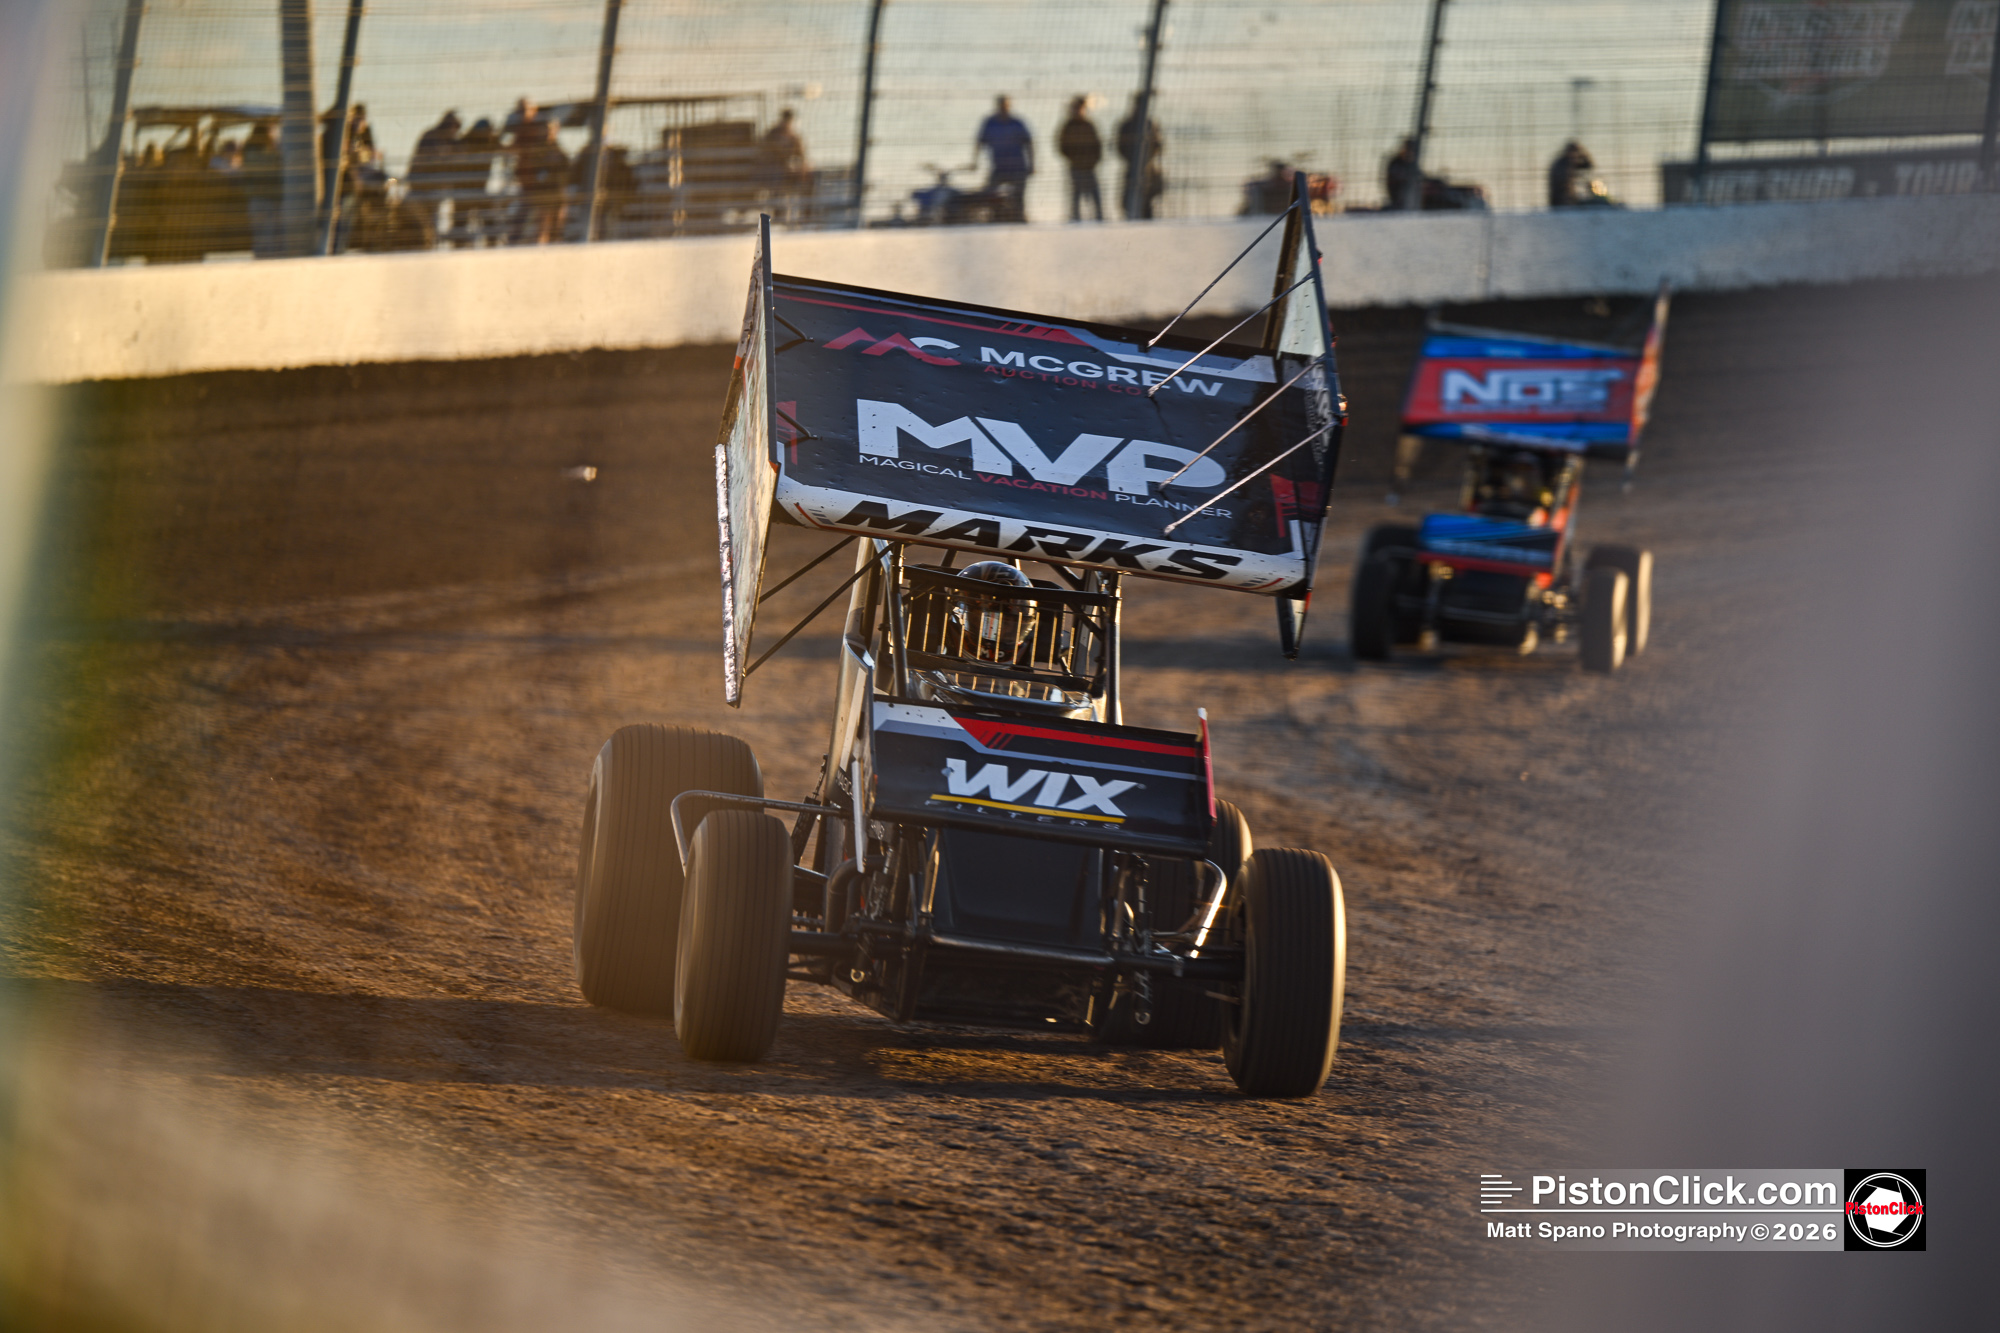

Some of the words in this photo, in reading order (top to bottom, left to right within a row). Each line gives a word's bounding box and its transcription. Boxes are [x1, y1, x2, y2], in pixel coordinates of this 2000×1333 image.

[980, 346, 1223, 396] MCGREW
[983, 365, 1097, 389] AUCTION
[857, 398, 1227, 496] MVP
[859, 454, 972, 480] MAGICAL
[977, 474, 1107, 501] VACATION
[1115, 493, 1233, 519] PLANNER
[835, 500, 1243, 580] MARKS
[925, 800, 1121, 830] FILTERS
[946, 757, 1138, 817] WIX
